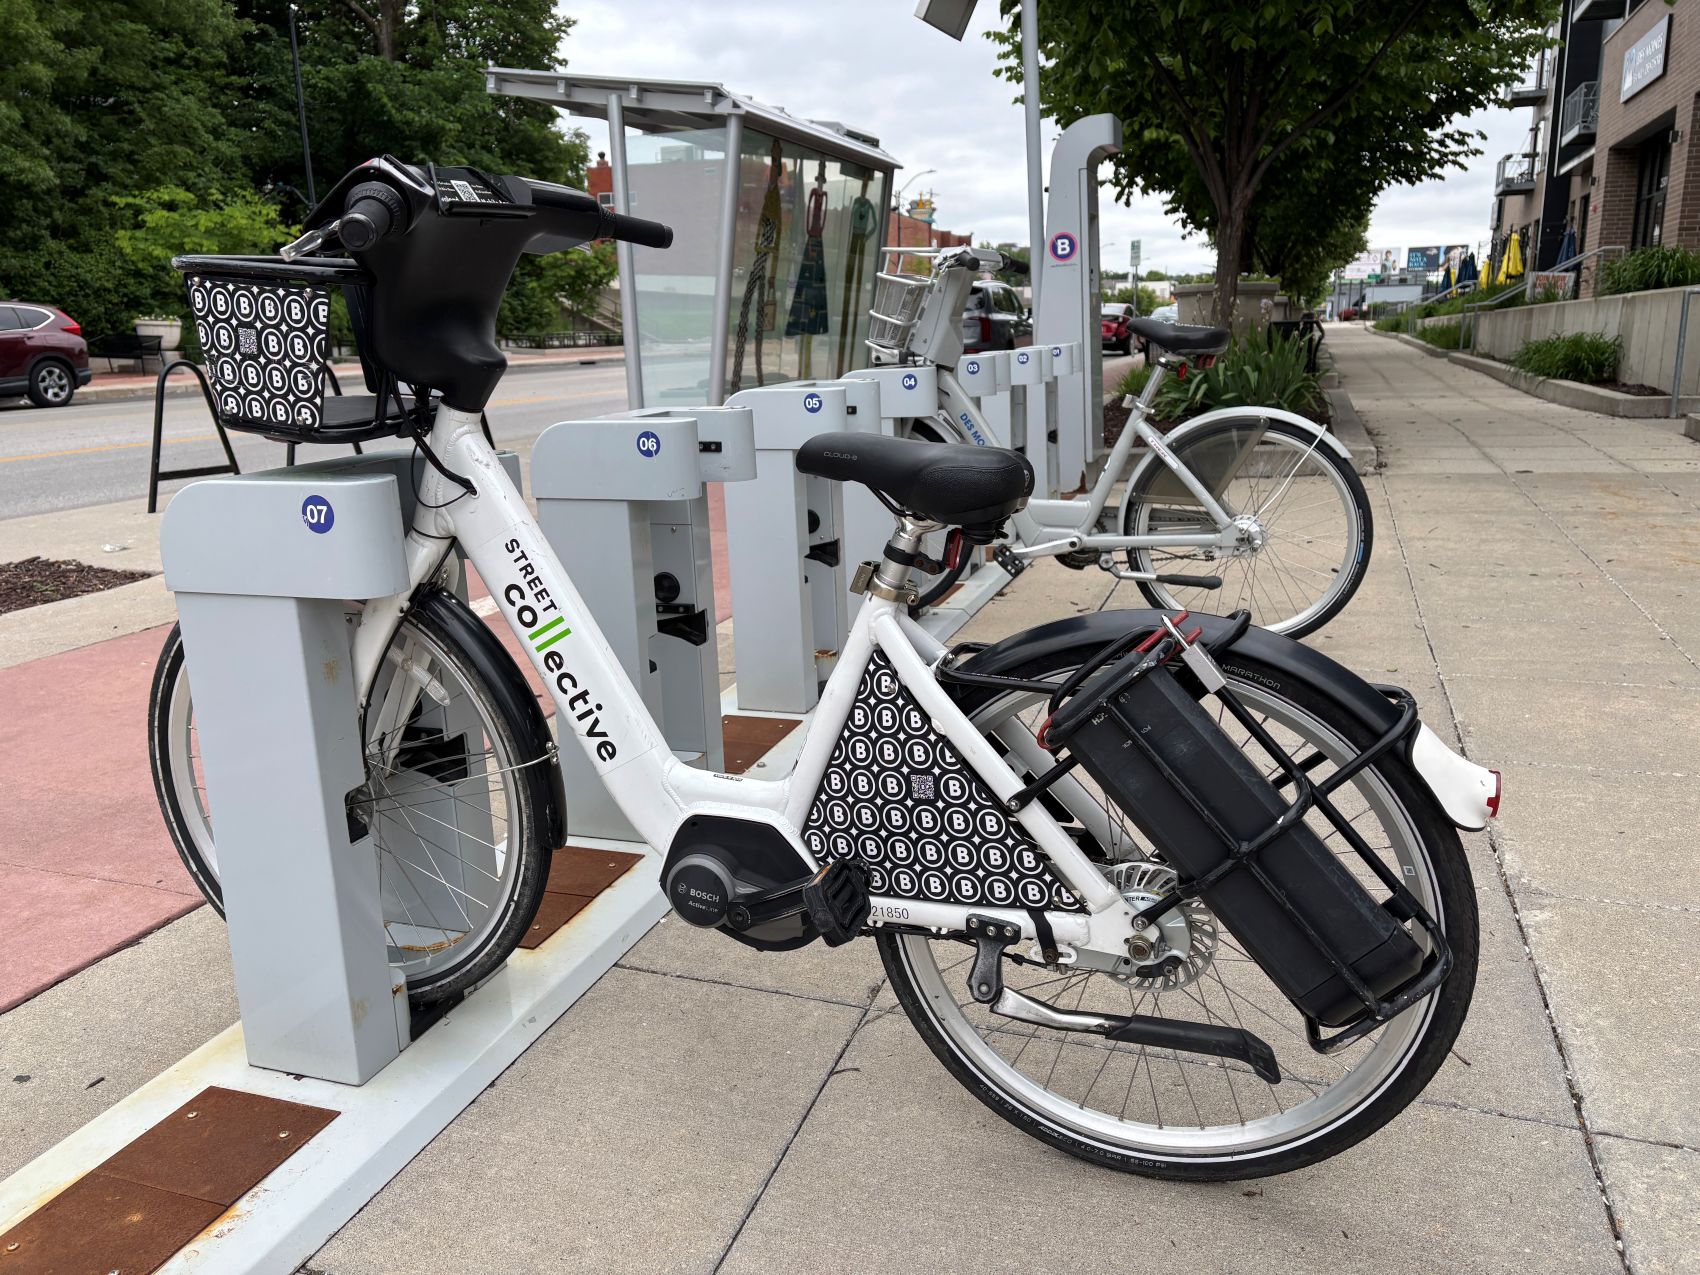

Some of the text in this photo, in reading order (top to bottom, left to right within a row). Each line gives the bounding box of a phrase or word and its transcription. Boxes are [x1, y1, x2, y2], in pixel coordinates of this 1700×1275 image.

[1056, 238, 1071, 255] B
[194, 291, 203, 308] B
[216, 294, 226, 311] B
[240, 297, 250, 314] B
[264, 299, 275, 317] B
[291, 302, 301, 320] B
[219, 329, 229, 346] B
[268, 335, 279, 352] B
[294, 338, 304, 356] B
[223, 363, 233, 381] B
[247, 367, 257, 384] B
[272, 370, 282, 387] B
[903, 378, 915, 386] 04
[251, 401, 262, 417] B
[276, 404, 286, 421] B
[805, 398, 820, 409] 05
[959, 412, 975, 432] DES
[639, 437, 657, 452] 06
[306, 505, 328, 524] 07
[504, 537, 558, 613] STREET
[504, 583, 617, 763] collective
[1221, 663, 1281, 690] MARATHON
[854, 709, 922, 728] B B B
[856, 742, 926, 761] B B B
[831, 774, 961, 796] B B B B
[833, 806, 998, 832] B B B B B B
[811, 835, 1036, 867] B B B B B B B B
[690, 888, 720, 903] BOSCH
[899, 874, 911, 890] B
[929, 877, 942, 893] B
[960, 880, 973, 896] B
[993, 882, 1007, 898] B
[1027, 884, 1040, 900] B
[871, 905, 909, 920] 21850
